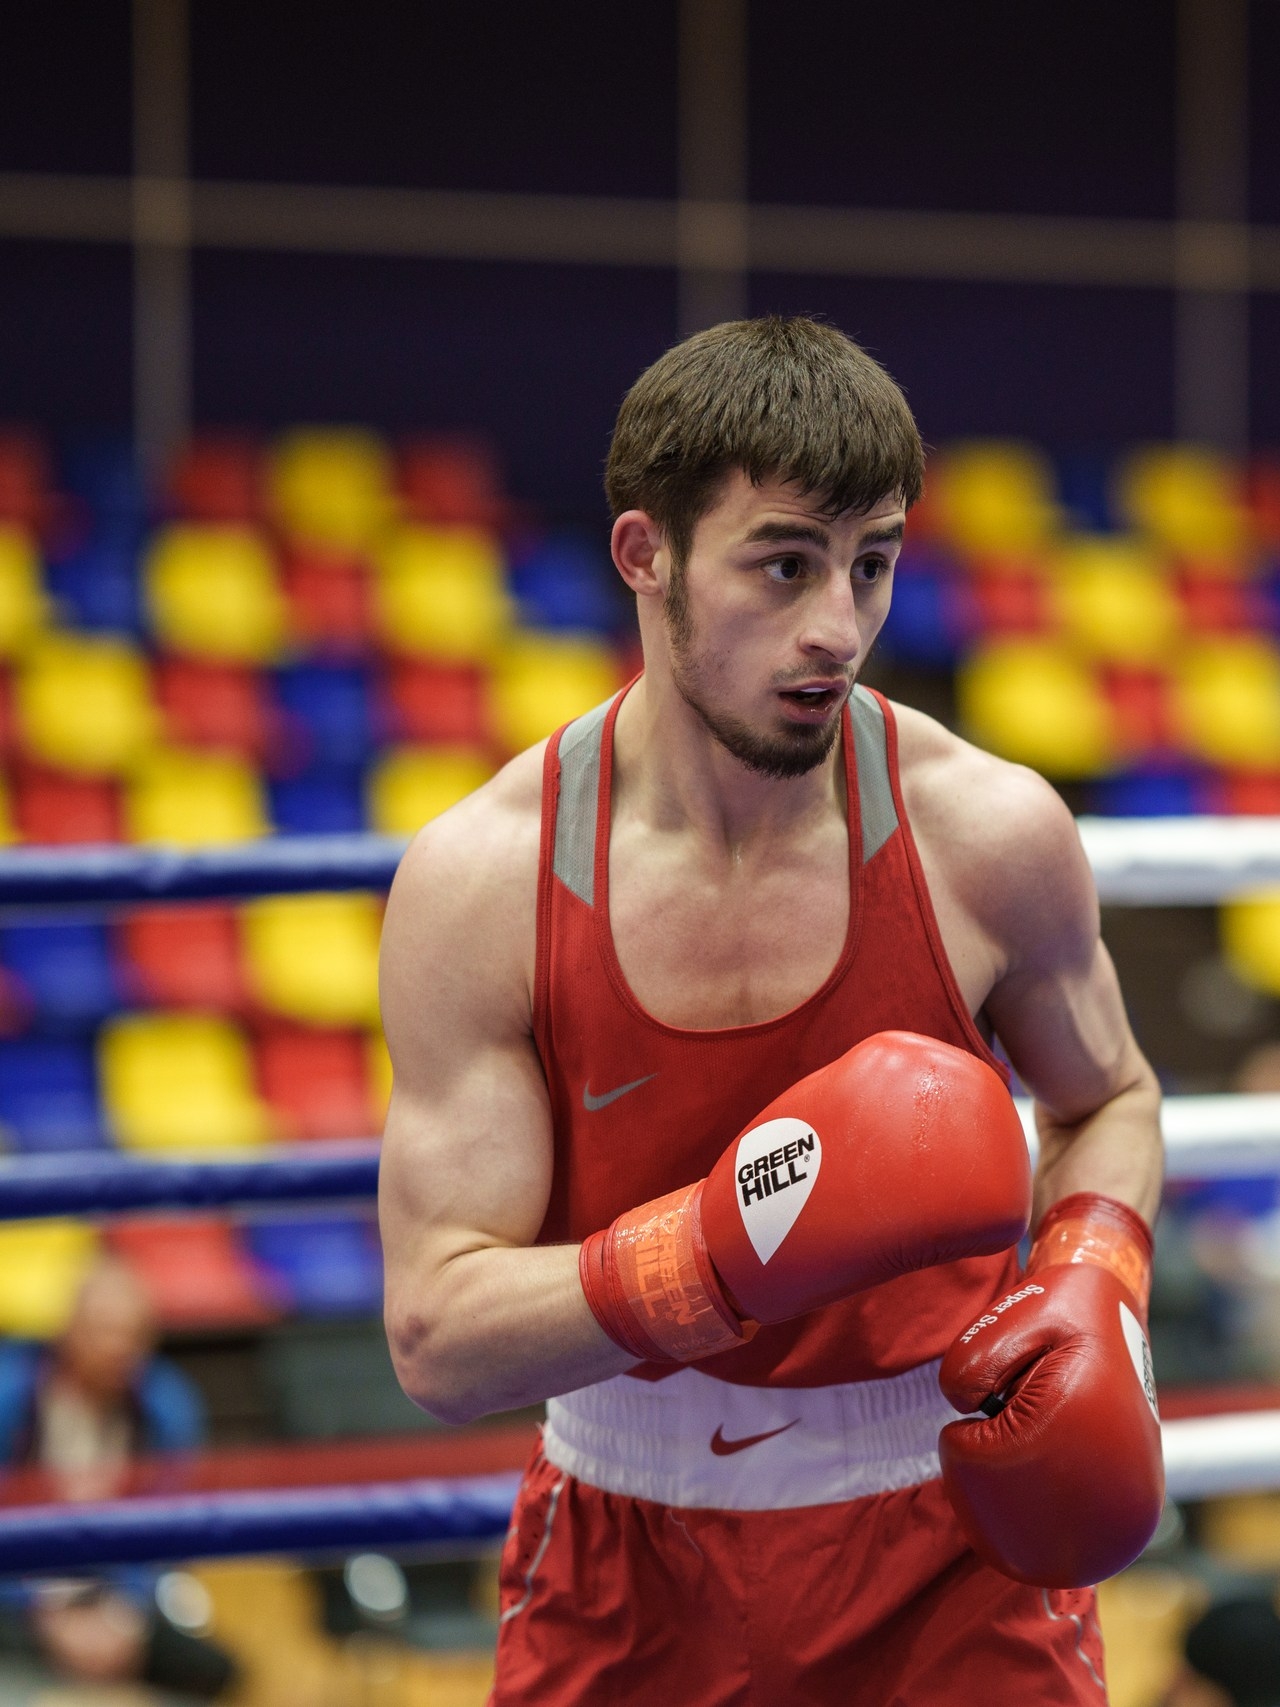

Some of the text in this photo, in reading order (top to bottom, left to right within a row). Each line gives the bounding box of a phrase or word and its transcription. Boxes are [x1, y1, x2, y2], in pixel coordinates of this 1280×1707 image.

[738, 1133, 815, 1185] GREEN
[741, 1161, 808, 1207] HILL
[960, 1284, 1045, 1344] Super Star
